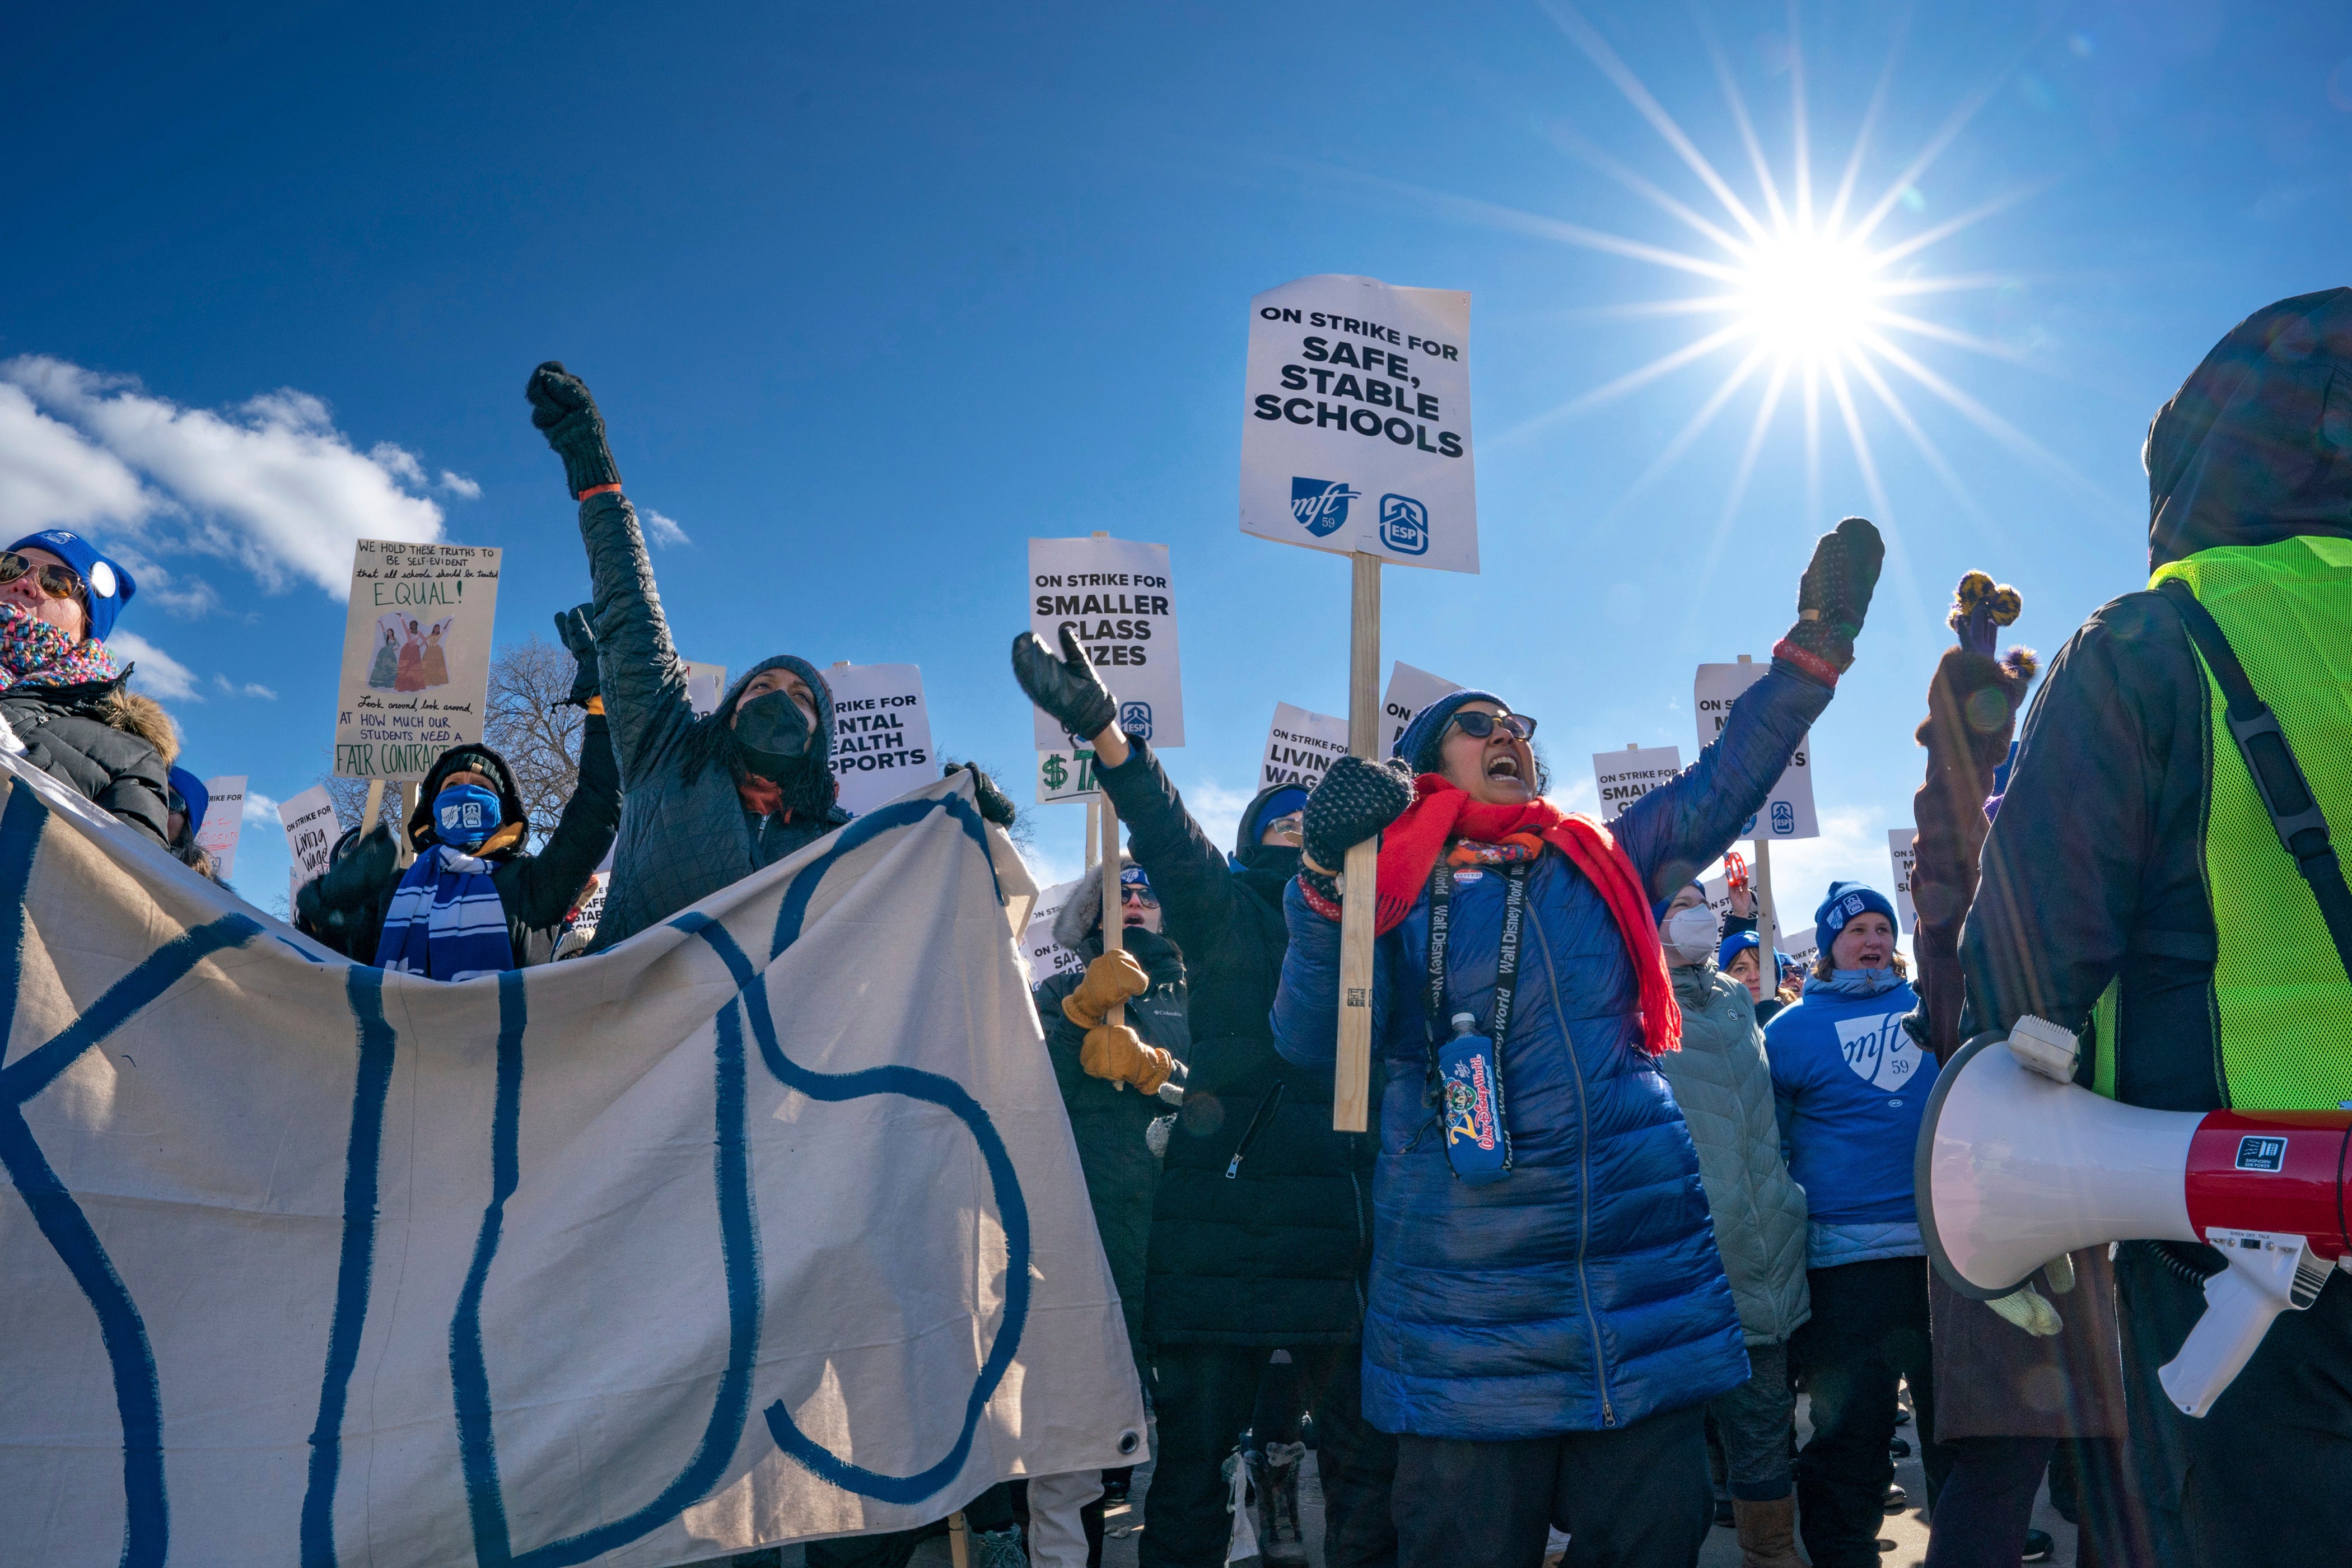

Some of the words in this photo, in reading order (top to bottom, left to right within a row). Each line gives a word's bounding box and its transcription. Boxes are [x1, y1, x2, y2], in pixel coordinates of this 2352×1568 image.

[1260, 306, 1301, 323] ON
[1310, 312, 1401, 346] STRIKE
[1408, 335, 1458, 362] FOR
[1302, 336, 1421, 389] SAFE,
[1280, 364, 1439, 421] STABLE
[1253, 394, 1464, 458] SCHOOLS
[1292, 482, 1362, 528] mft
[1322, 516, 1335, 528] 59
[1392, 525, 1417, 541] ESP
[358, 540, 376, 553] WE
[381, 543, 406, 555] HOLD
[409, 545, 436, 556] THESE
[439, 547, 475, 557] TRUTHS
[480, 549, 494, 558] TO
[386, 556, 400, 566] BE
[408, 557, 469, 567] SELF-EVIDENT
[356, 568, 379, 578] that
[384, 568, 398, 579] all
[402, 569, 432, 579] schools
[435, 569, 462, 579] should
[464, 569, 475, 578] be
[1035, 574, 1062, 587] ON
[1067, 573, 1128, 587] STRIKE
[1134, 574, 1166, 588] FOR
[374, 580, 463, 606] EQUAL!
[1036, 594, 1169, 615] SMALLER
[1085, 645, 1147, 666] IZES
[357, 696, 384, 709] Look
[388, 698, 418, 712] around,
[421, 700, 440, 711] look
[443, 702, 473, 715] around,
[835, 699, 875, 714] RIKE
[880, 695, 917, 708] FOR
[1387, 703, 1411, 721] ON
[1700, 700, 1721, 711] ON
[339, 712, 353, 725] AT
[360, 713, 386, 726] HOW
[393, 716, 424, 728] MUCH
[428, 716, 451, 728] OUR
[835, 713, 903, 735] NTAL
[1128, 723, 1145, 732] ESP
[360, 730, 413, 741] STUDENTS
[421, 730, 450, 742] NEED
[454, 732, 463, 742] A
[831, 731, 903, 756] EALTH
[1273, 729, 1289, 740] ON
[1290, 734, 1328, 749] STRIKE
[336, 744, 375, 776] FAIR
[828, 749, 926, 774] PPORTS
[1270, 744, 1331, 773] LIVIN
[1265, 764, 1318, 790] WAG
[1600, 774, 1616, 783] ON
[1619, 771, 1655, 781] STRIKE
[286, 822, 295, 832] ON
[295, 812, 317, 828] STRIKE
[317, 805, 332, 818] FOR
[294, 828, 328, 858] Living
[1435, 868, 1448, 895] World
[1507, 880, 1524, 906] World
[585, 897, 605, 908] AFE
[1432, 905, 1448, 930] Walt
[1502, 907, 1522, 943] Disney
[1034, 945, 1051, 956] ON
[1430, 932, 1446, 976] Disney
[1499, 945, 1516, 974] Walt
[1431, 976, 1444, 1009] Wor
[1495, 988, 1511, 1030] World
[1844, 1011, 1910, 1082] mft
[1892, 1060, 1909, 1074] 59
